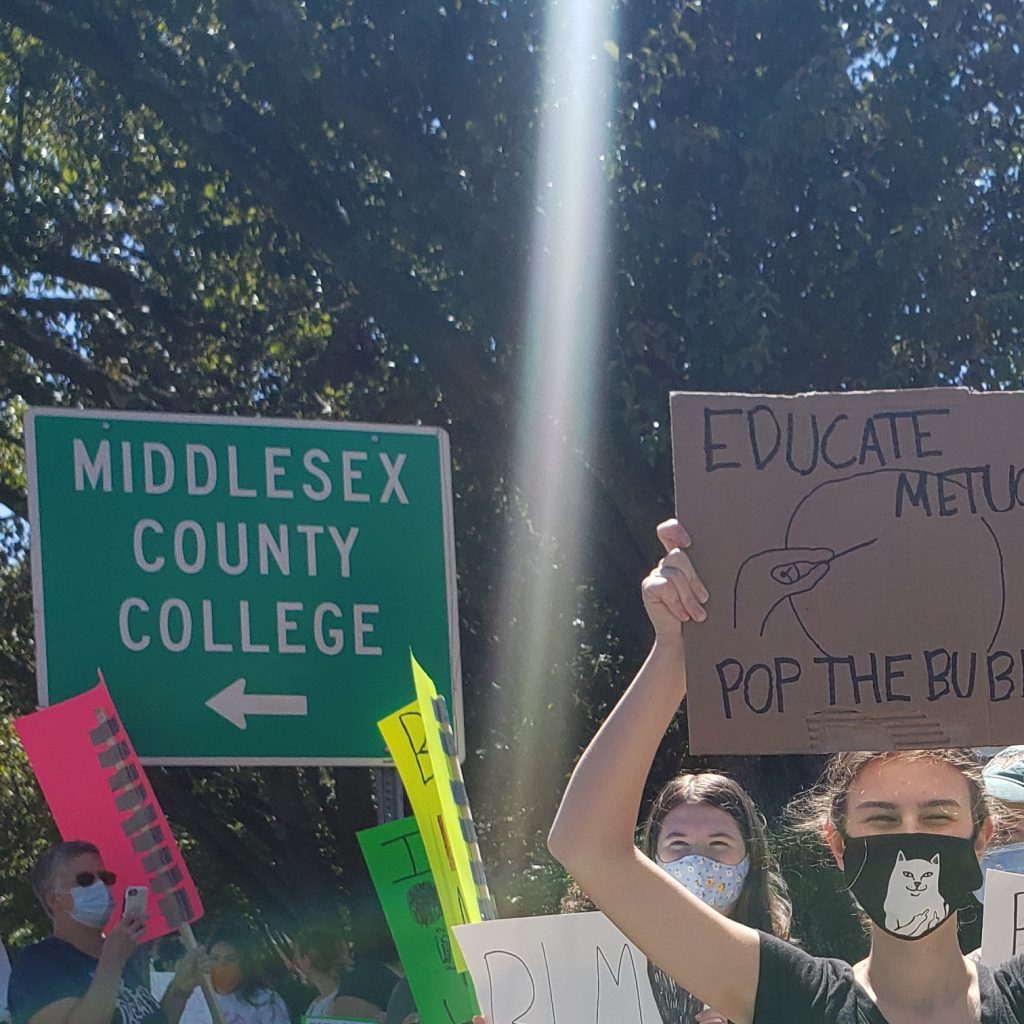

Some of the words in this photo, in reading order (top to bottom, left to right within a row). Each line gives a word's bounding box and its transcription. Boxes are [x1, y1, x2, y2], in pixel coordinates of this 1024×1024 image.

[73, 438, 409, 504] MIDDLESEX
[704, 405, 950, 475] EDUCATE
[133, 519, 359, 577] COUNTY
[119, 598, 382, 655] COLLEGE
[716, 657, 801, 719] POP
[814, 652, 911, 705] THE
